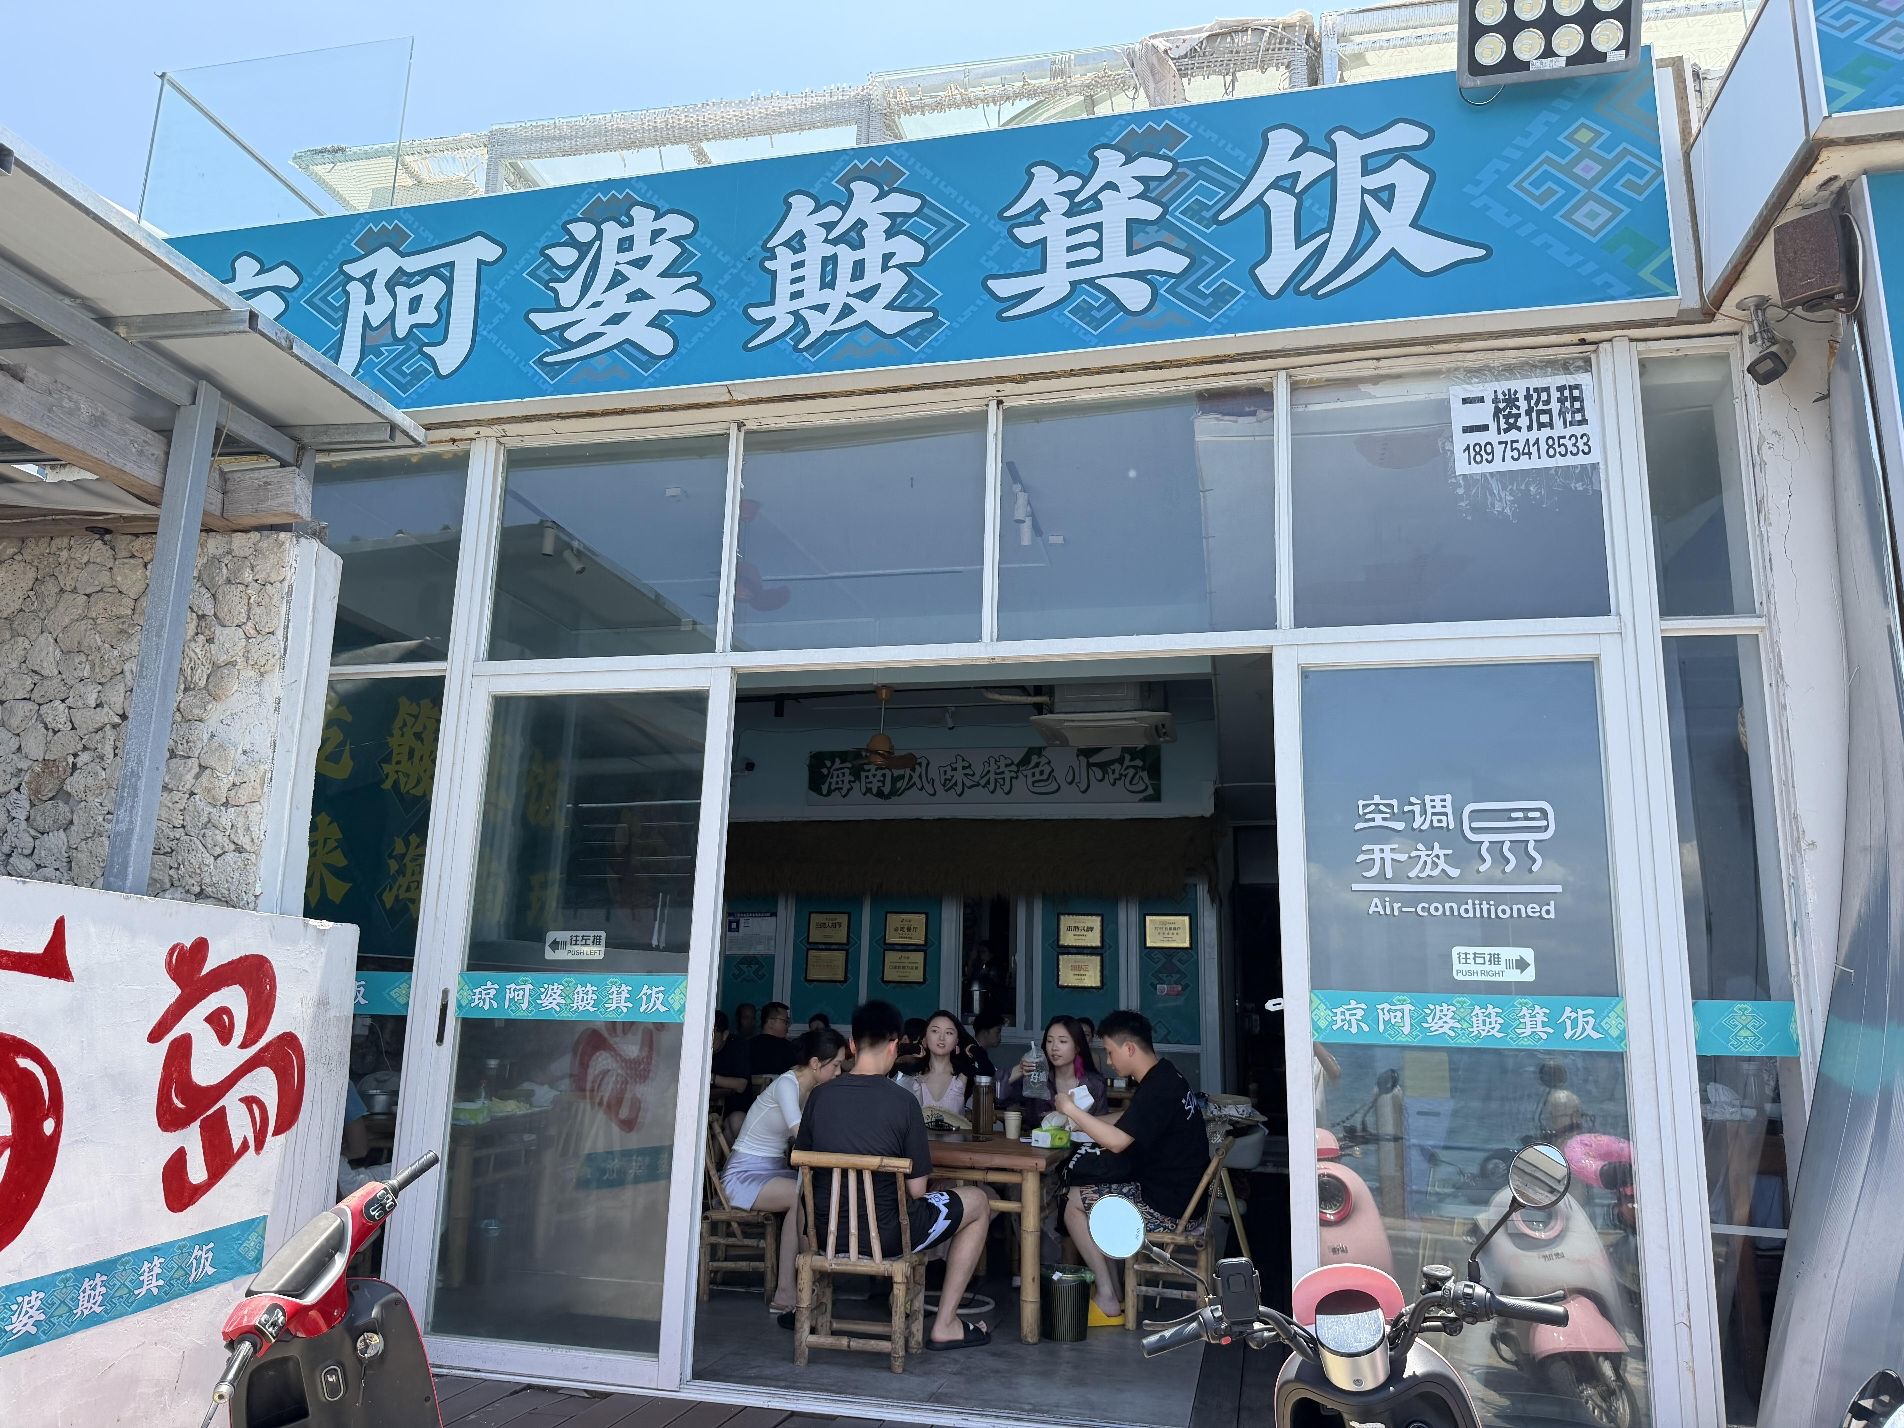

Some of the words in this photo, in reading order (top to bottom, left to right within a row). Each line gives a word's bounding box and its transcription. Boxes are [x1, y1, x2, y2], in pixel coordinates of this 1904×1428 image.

[1461, 384, 1589, 435] 二楼招租
[820, 754, 1148, 798] 海南风味特色小吃
[1354, 794, 1455, 832] 空调
[1355, 842, 1461, 880] 开放
[1368, 897, 1556, 920] Air-conditioned
[570, 935, 602, 946] 往左推
[1457, 952, 1502, 966] 往右推
[1456, 969, 1479, 977] PUSH
[1480, 970, 1505, 978] RIGHT
[470, 982, 670, 1014] 琼阿婆簸箕饭
[1330, 999, 1605, 1041] 琼阿婆簸箕饭
[4, 1241, 217, 1342] 婆簸箕饭
